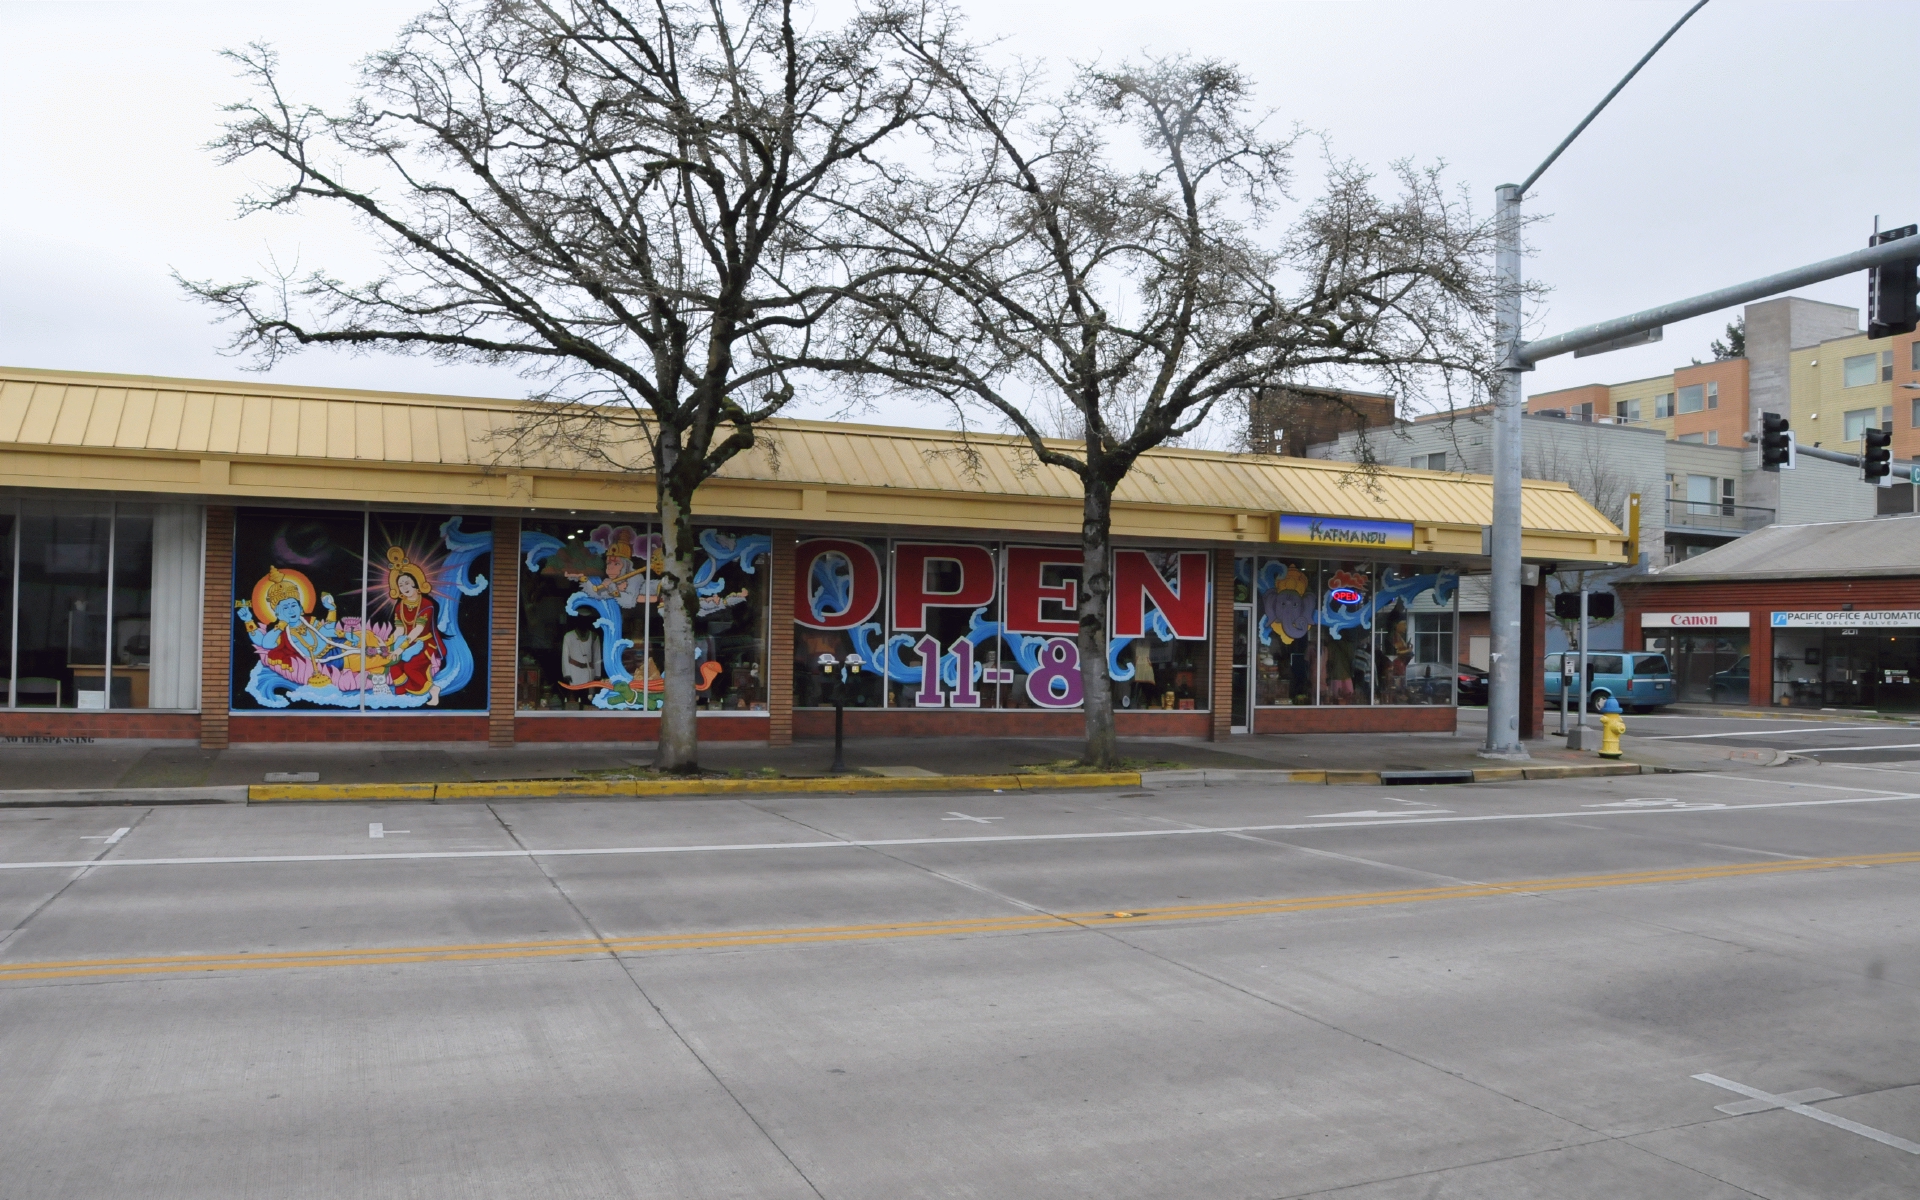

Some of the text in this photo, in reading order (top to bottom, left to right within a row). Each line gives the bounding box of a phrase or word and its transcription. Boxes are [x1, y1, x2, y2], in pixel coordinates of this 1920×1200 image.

[793, 537, 1209, 640] OPEN
[1334, 592, 1358, 601] OPEN
[1670, 614, 1718, 626] Canon
[1787, 612, 1823, 620] PACIFIC
[1826, 612, 1860, 620] OFFICE
[913, 633, 1084, 709] 11-8
[4, 736, 95, 744] NO TRESPASSING
